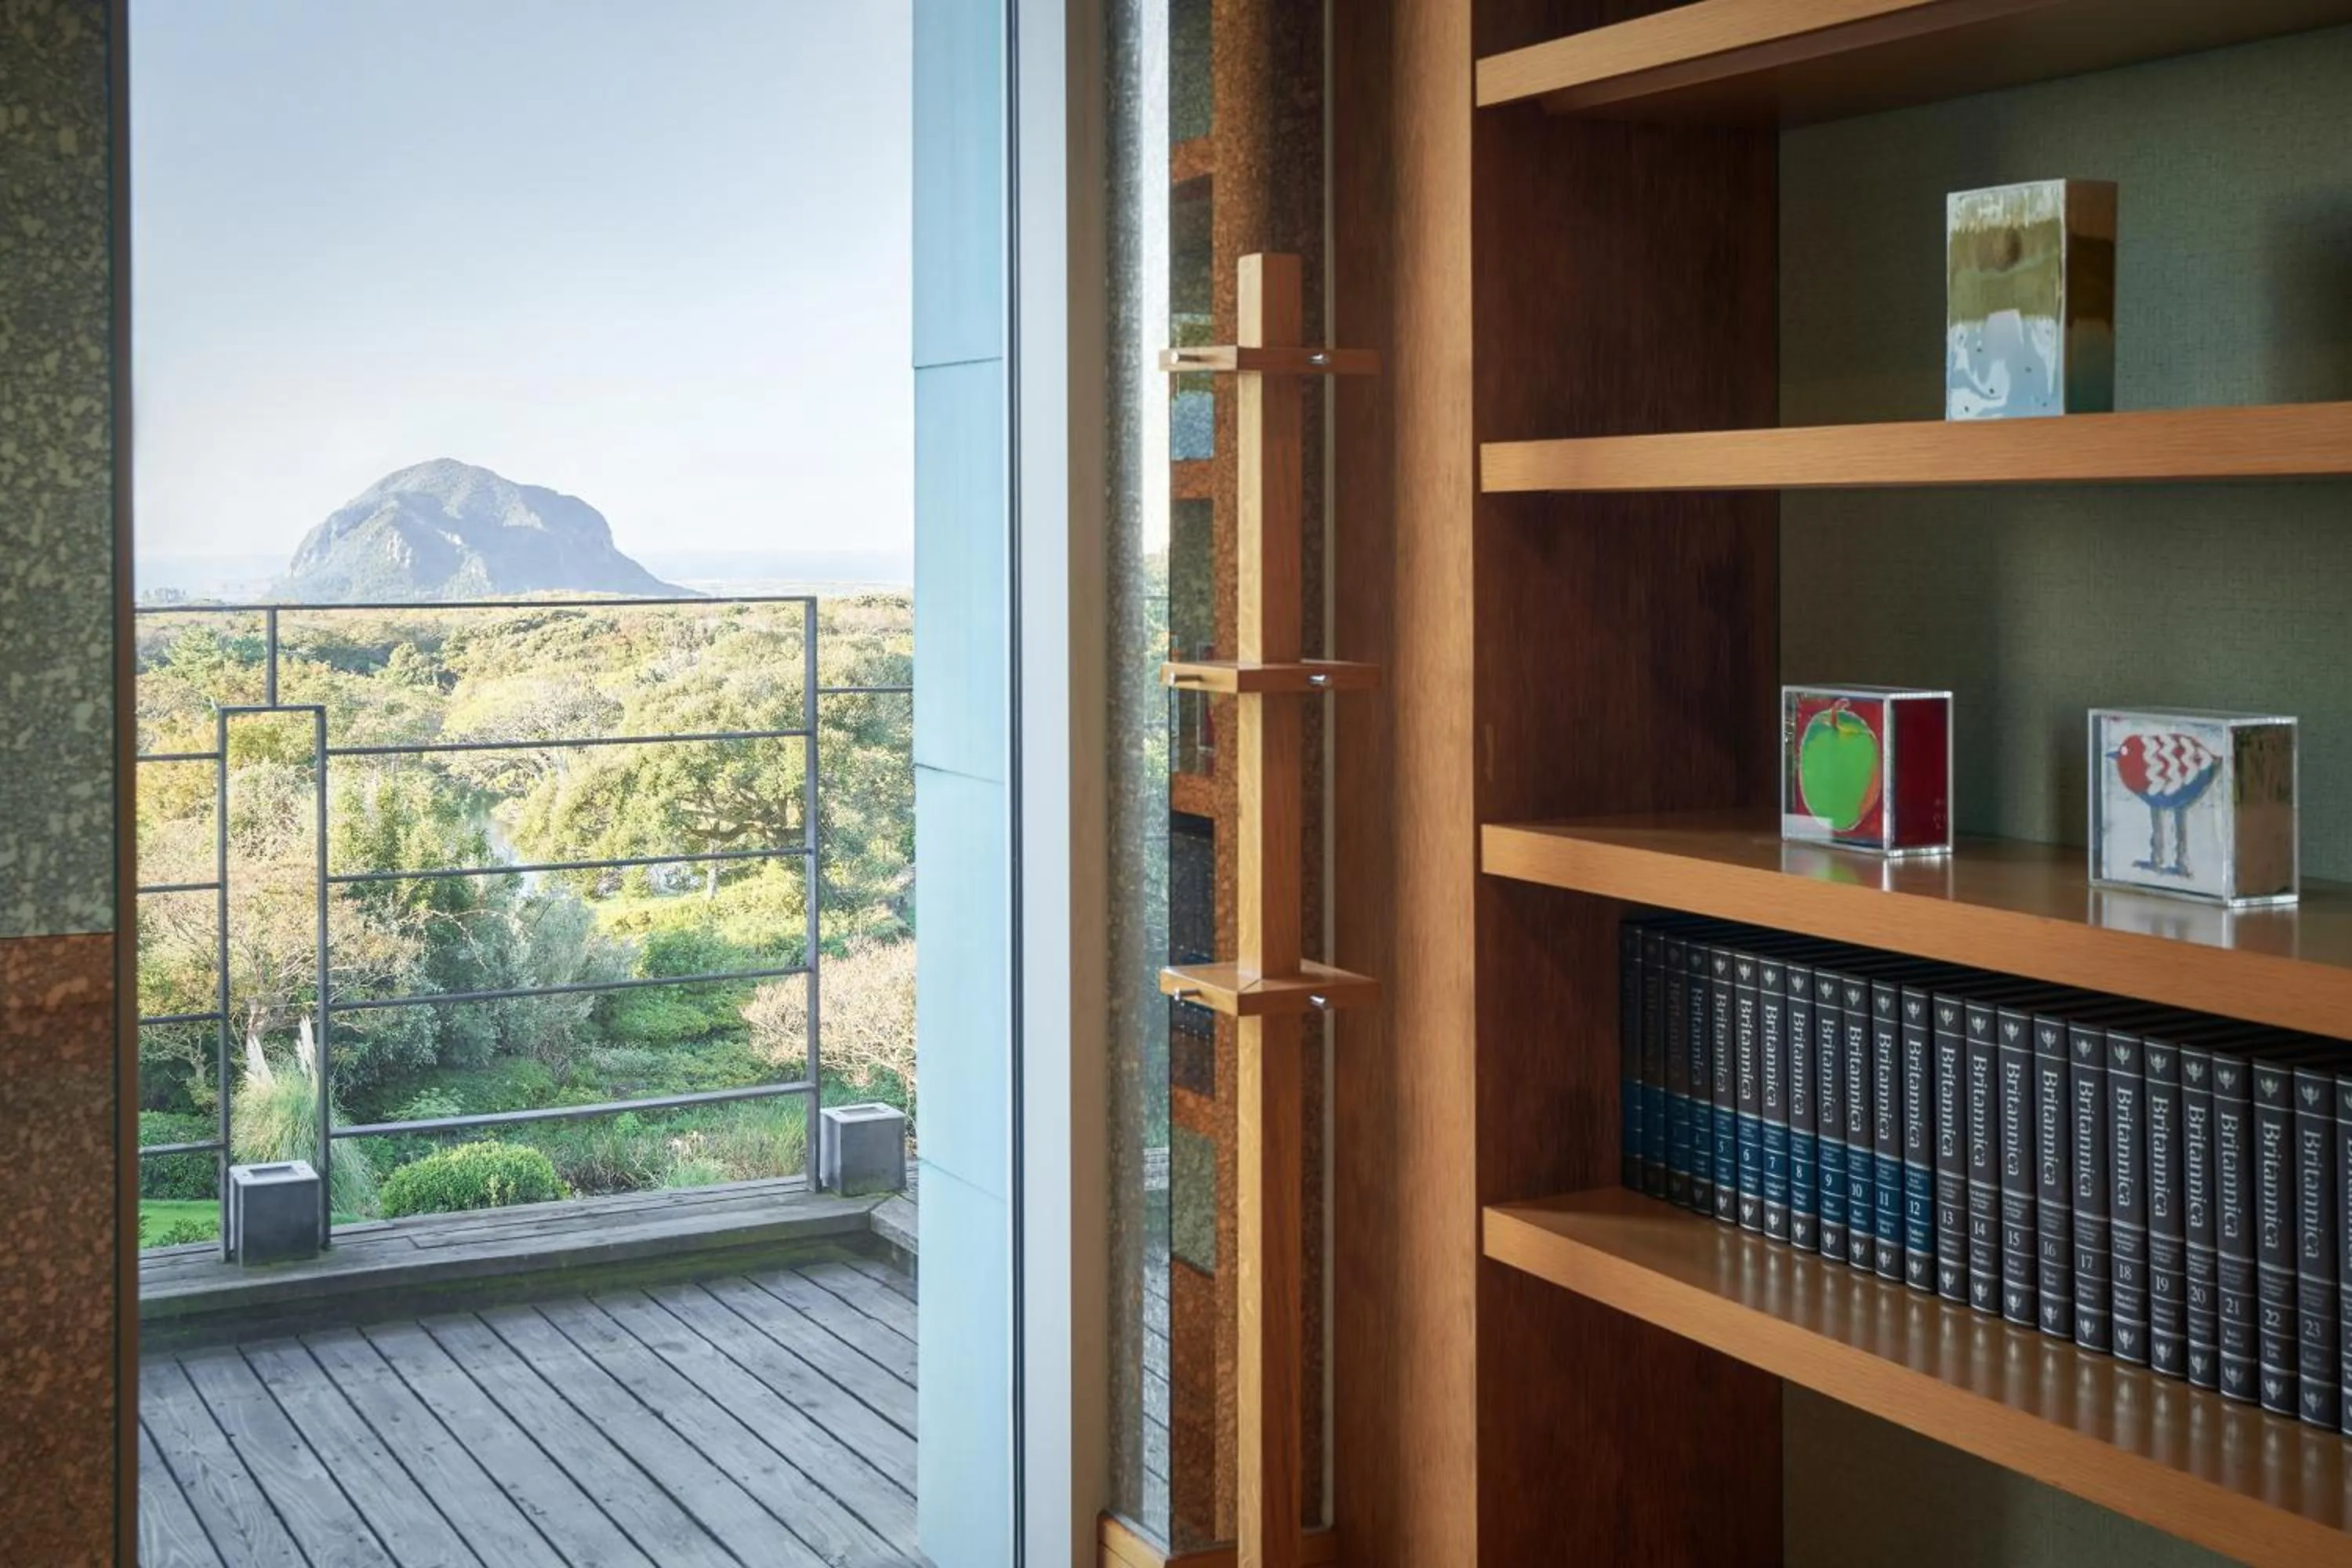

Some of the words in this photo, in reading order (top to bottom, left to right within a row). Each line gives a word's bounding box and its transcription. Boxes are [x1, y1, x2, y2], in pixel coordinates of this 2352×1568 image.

[1715, 993, 1728, 1092] Britannica
[1740, 999, 1754, 1100] Britannica
[1765, 1004, 1779, 1107] Britannica
[1793, 1011, 1806, 1115] Britannica
[1821, 1018, 1835, 1123] Britannica
[1849, 1025, 1864, 1132] Britannica
[1878, 1033, 1893, 1140] Britannica
[1908, 1039, 1922, 1149] Britannica
[1941, 1046, 1956, 1157] Britannica
[1973, 1054, 1987, 1167] Britannica
[2006, 1062, 2020, 1176] Britannica
[2042, 1069, 2058, 1185] Britannica
[2078, 1080, 2094, 1197] Britannica
[1743, 1148, 1750, 1162] 6
[1769, 1156, 1776, 1169] 7
[1796, 1164, 1802, 1179] 8
[1824, 1173, 1832, 1187] 9
[1851, 1183, 1863, 1198] 10
[2116, 1087, 2133, 1207] Britannica
[2152, 1095, 2170, 1218] Britannica
[2188, 1104, 2207, 1228] Britannica
[2220, 1112, 2240, 1238] Britannica
[2263, 1121, 2281, 1248] Britannica
[2303, 1130, 2322, 1258] Britannica
[1879, 1191, 1889, 1207] 11
[1910, 1200, 1920, 1216] 12
[1942, 1210, 1954, 1225] 13
[1974, 1221, 1986, 1236] 14
[2008, 1230, 2020, 1247] 15
[2044, 1241, 2056, 1257] 16
[2081, 1254, 2092, 1269] 17
[2119, 1263, 2132, 1280] 18
[2155, 1275, 2169, 1292] 19
[2225, 1297, 2239, 1315] 21
[2264, 1308, 2280, 1327] 22
[2304, 1319, 2321, 1338] 23
